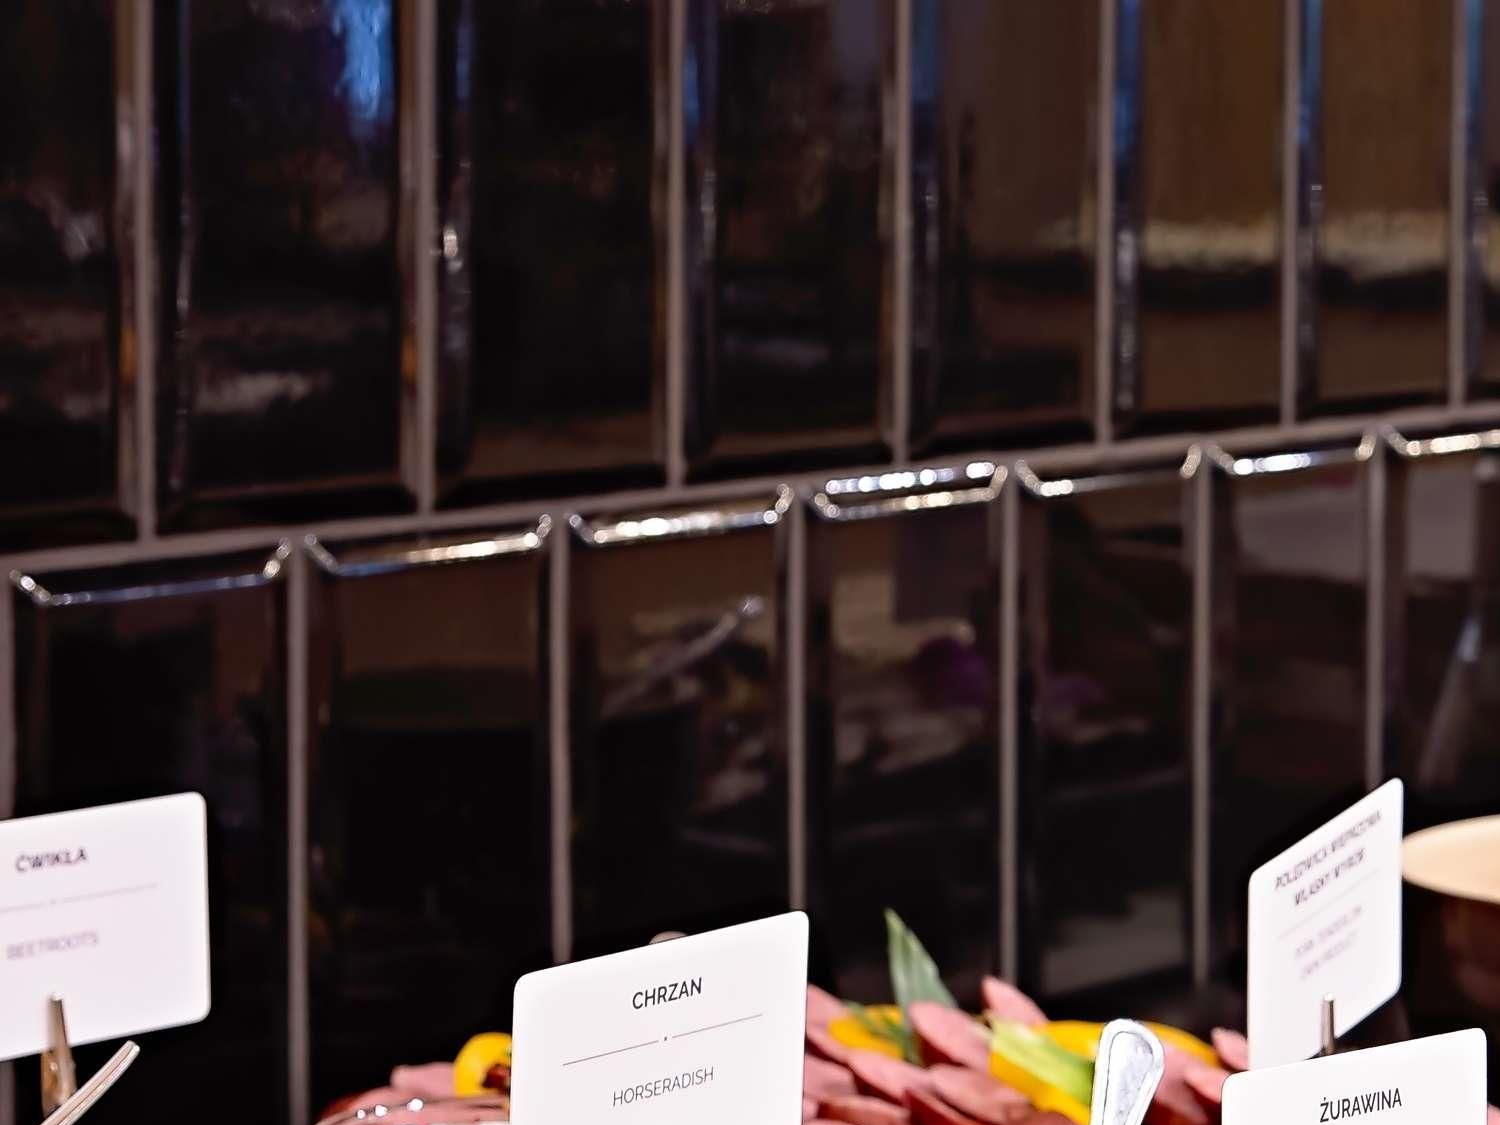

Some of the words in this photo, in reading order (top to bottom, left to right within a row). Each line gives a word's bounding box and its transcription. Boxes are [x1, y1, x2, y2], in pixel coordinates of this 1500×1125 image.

[631, 976, 703, 1010] CHRZAN
[612, 1065, 714, 1108] HORSERADISH
[1319, 1087, 1402, 1124] ŻURAWINA
